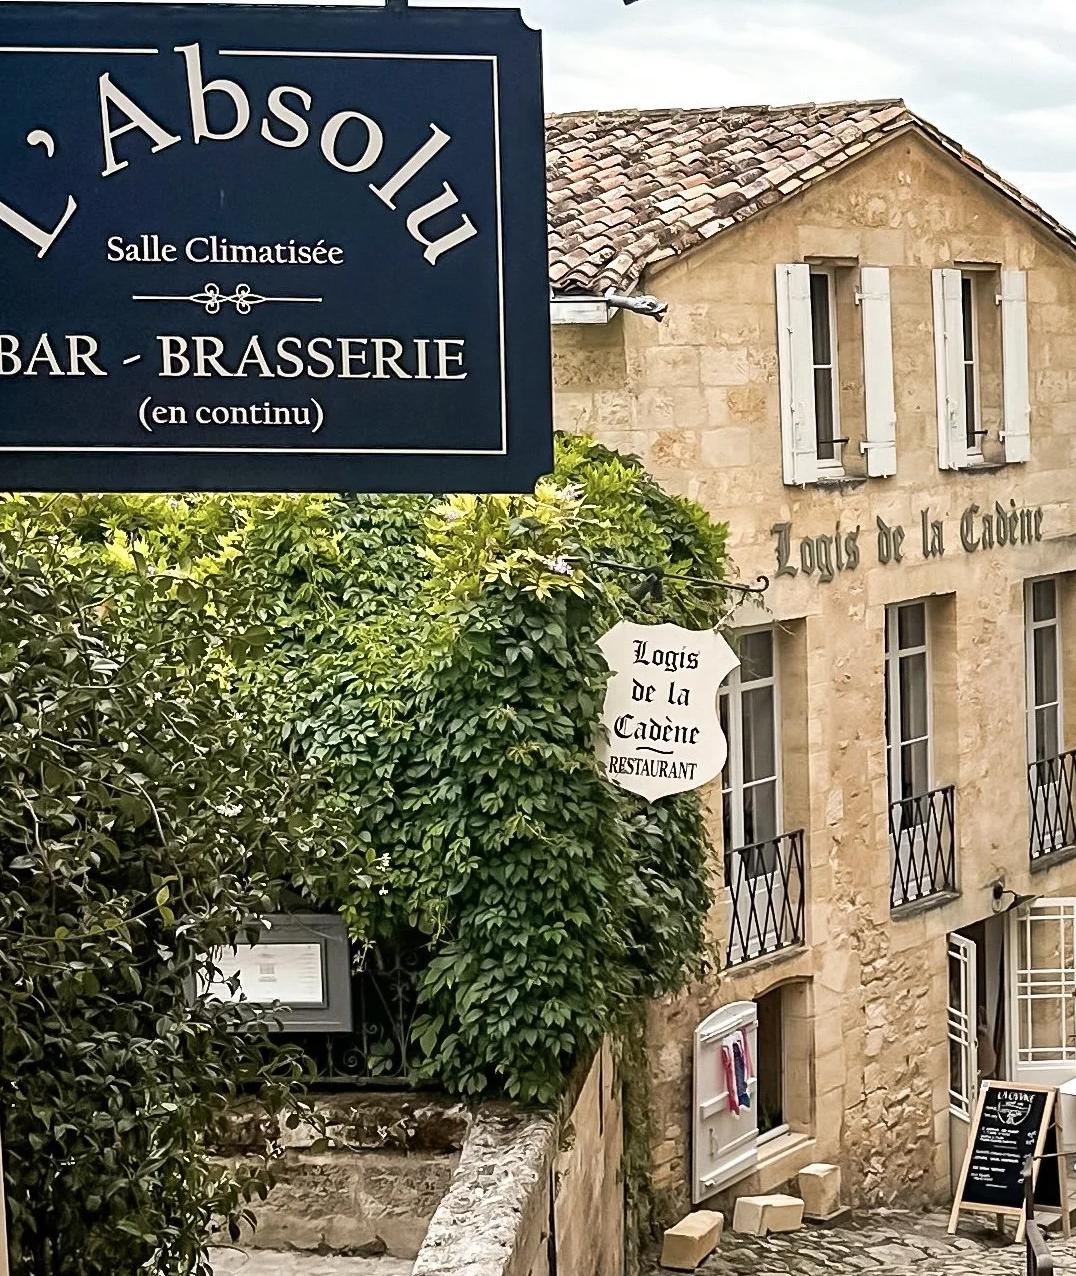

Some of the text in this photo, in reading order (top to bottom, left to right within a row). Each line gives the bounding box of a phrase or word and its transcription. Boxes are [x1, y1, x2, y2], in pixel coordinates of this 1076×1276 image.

[0, 43, 478, 266] L'Absolu
[107, 234, 344, 265] Salle Climatisée
[0, 332, 108, 376] BAR
[156, 334, 468, 380] BRASSERIE
[138, 396, 324, 433] (en continu)
[770, 498, 1044, 583] Logis de la Cadène
[632, 639, 701, 673] Logis
[631, 677, 690, 706] de la
[613, 713, 701, 744] Cadène
[608, 755, 698, 780] RESTAURANT
